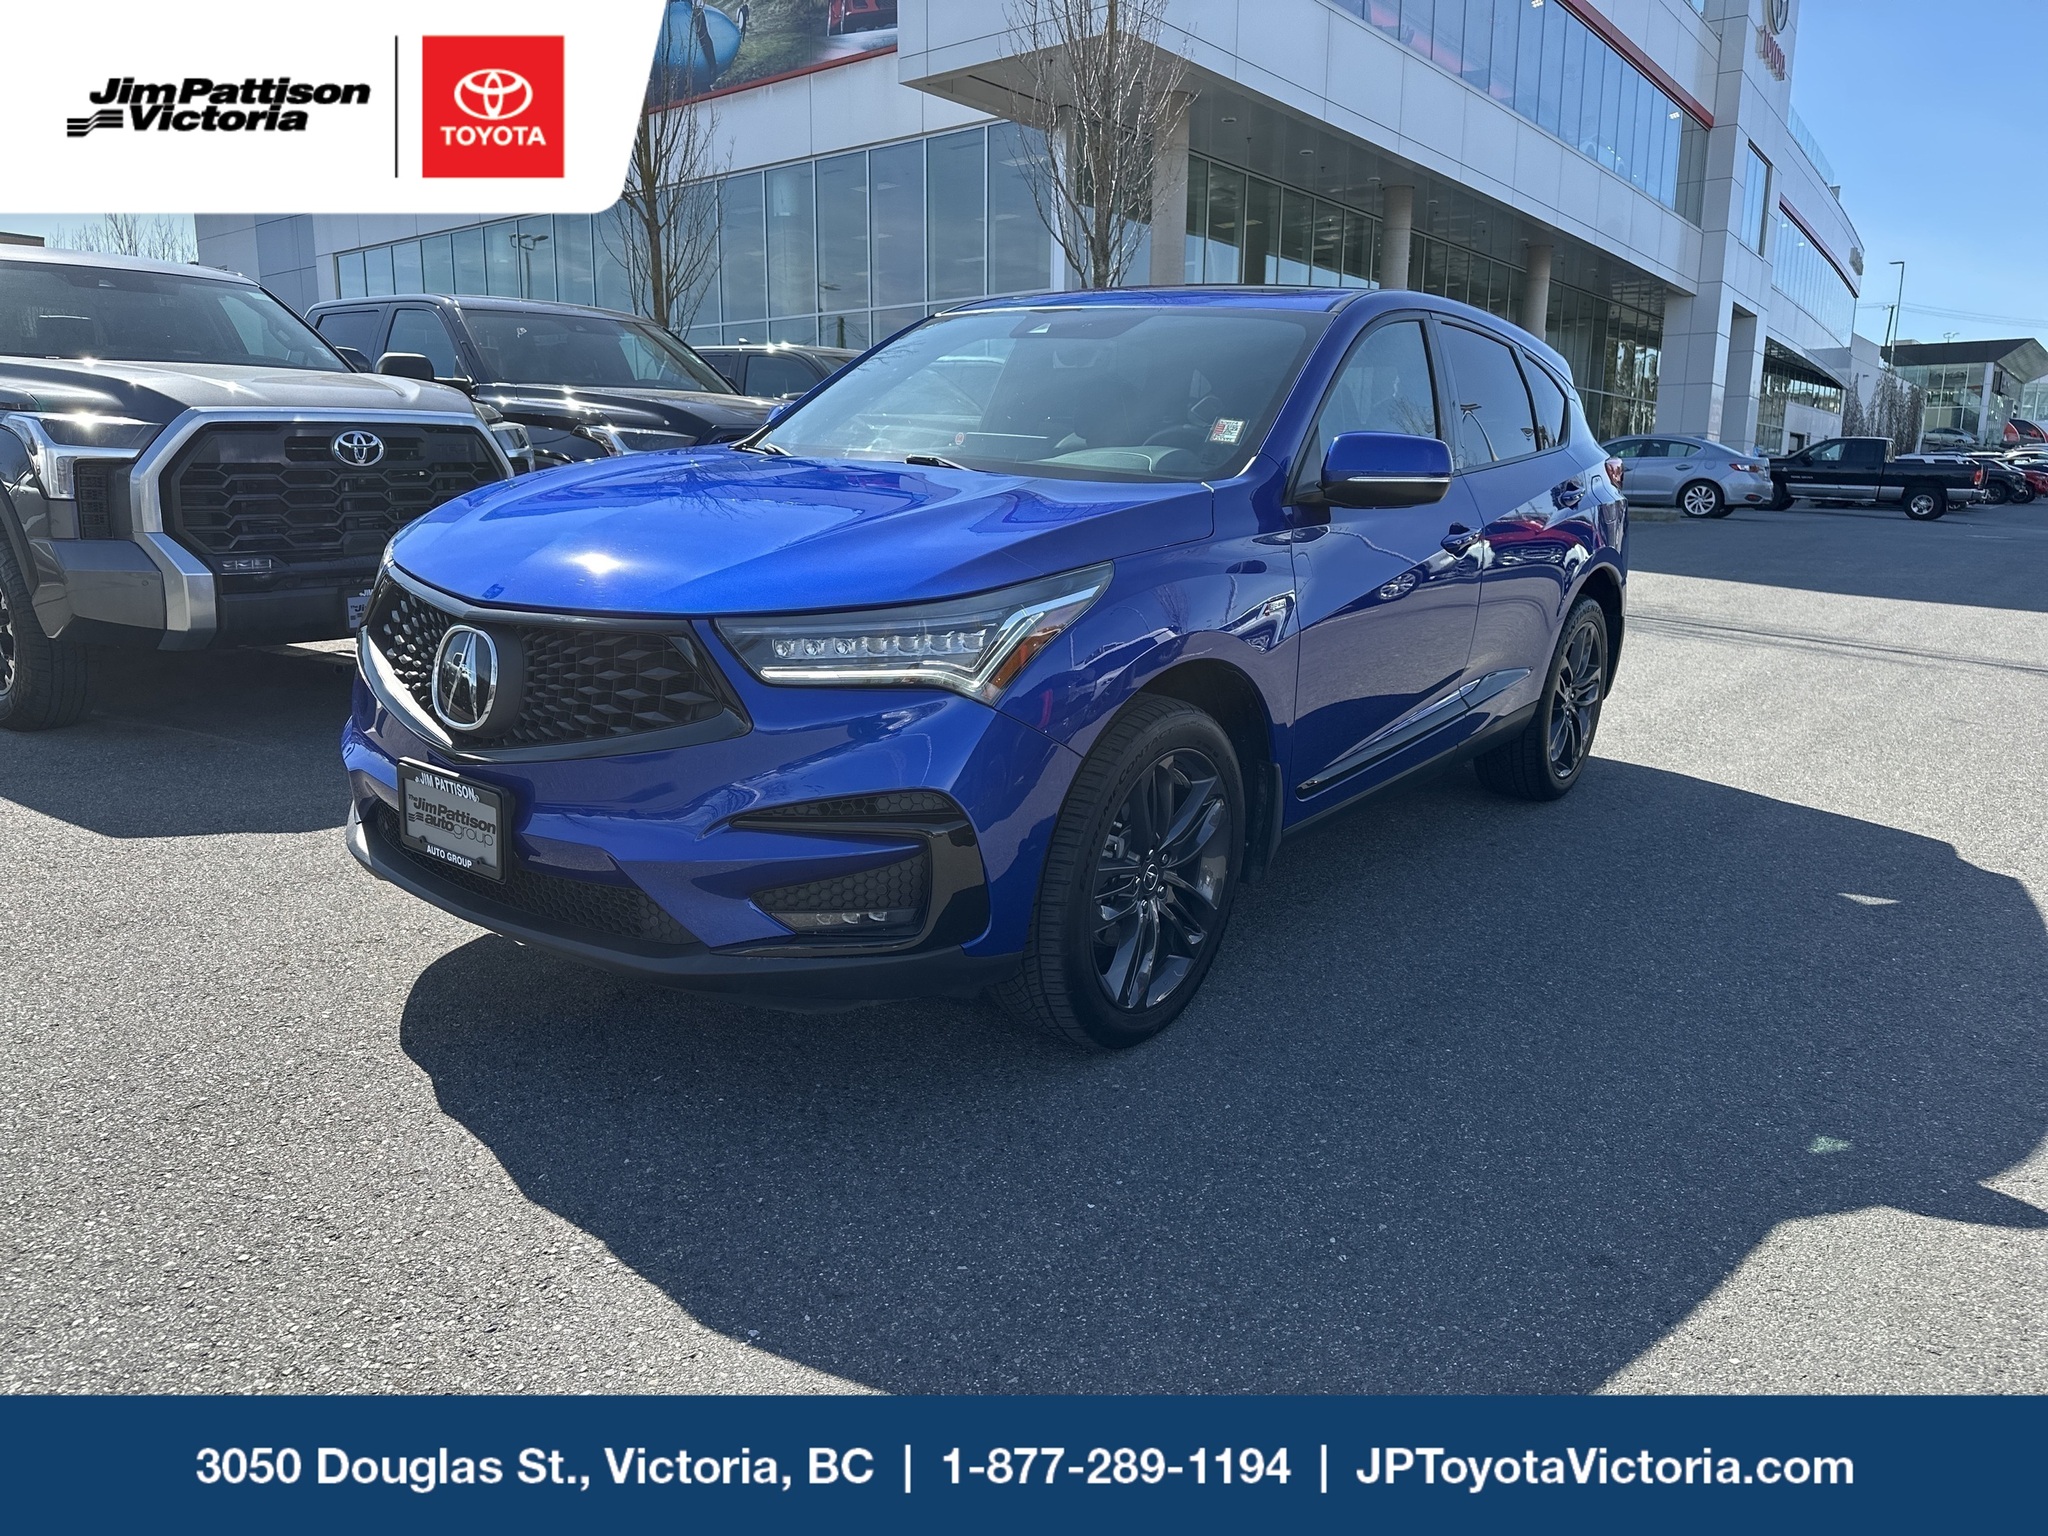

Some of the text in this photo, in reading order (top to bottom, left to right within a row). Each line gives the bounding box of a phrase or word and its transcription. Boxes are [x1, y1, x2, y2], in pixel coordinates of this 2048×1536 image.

[419, 772, 475, 801] JIM PATTISON
[426, 844, 473, 869] AUTO GROUP
